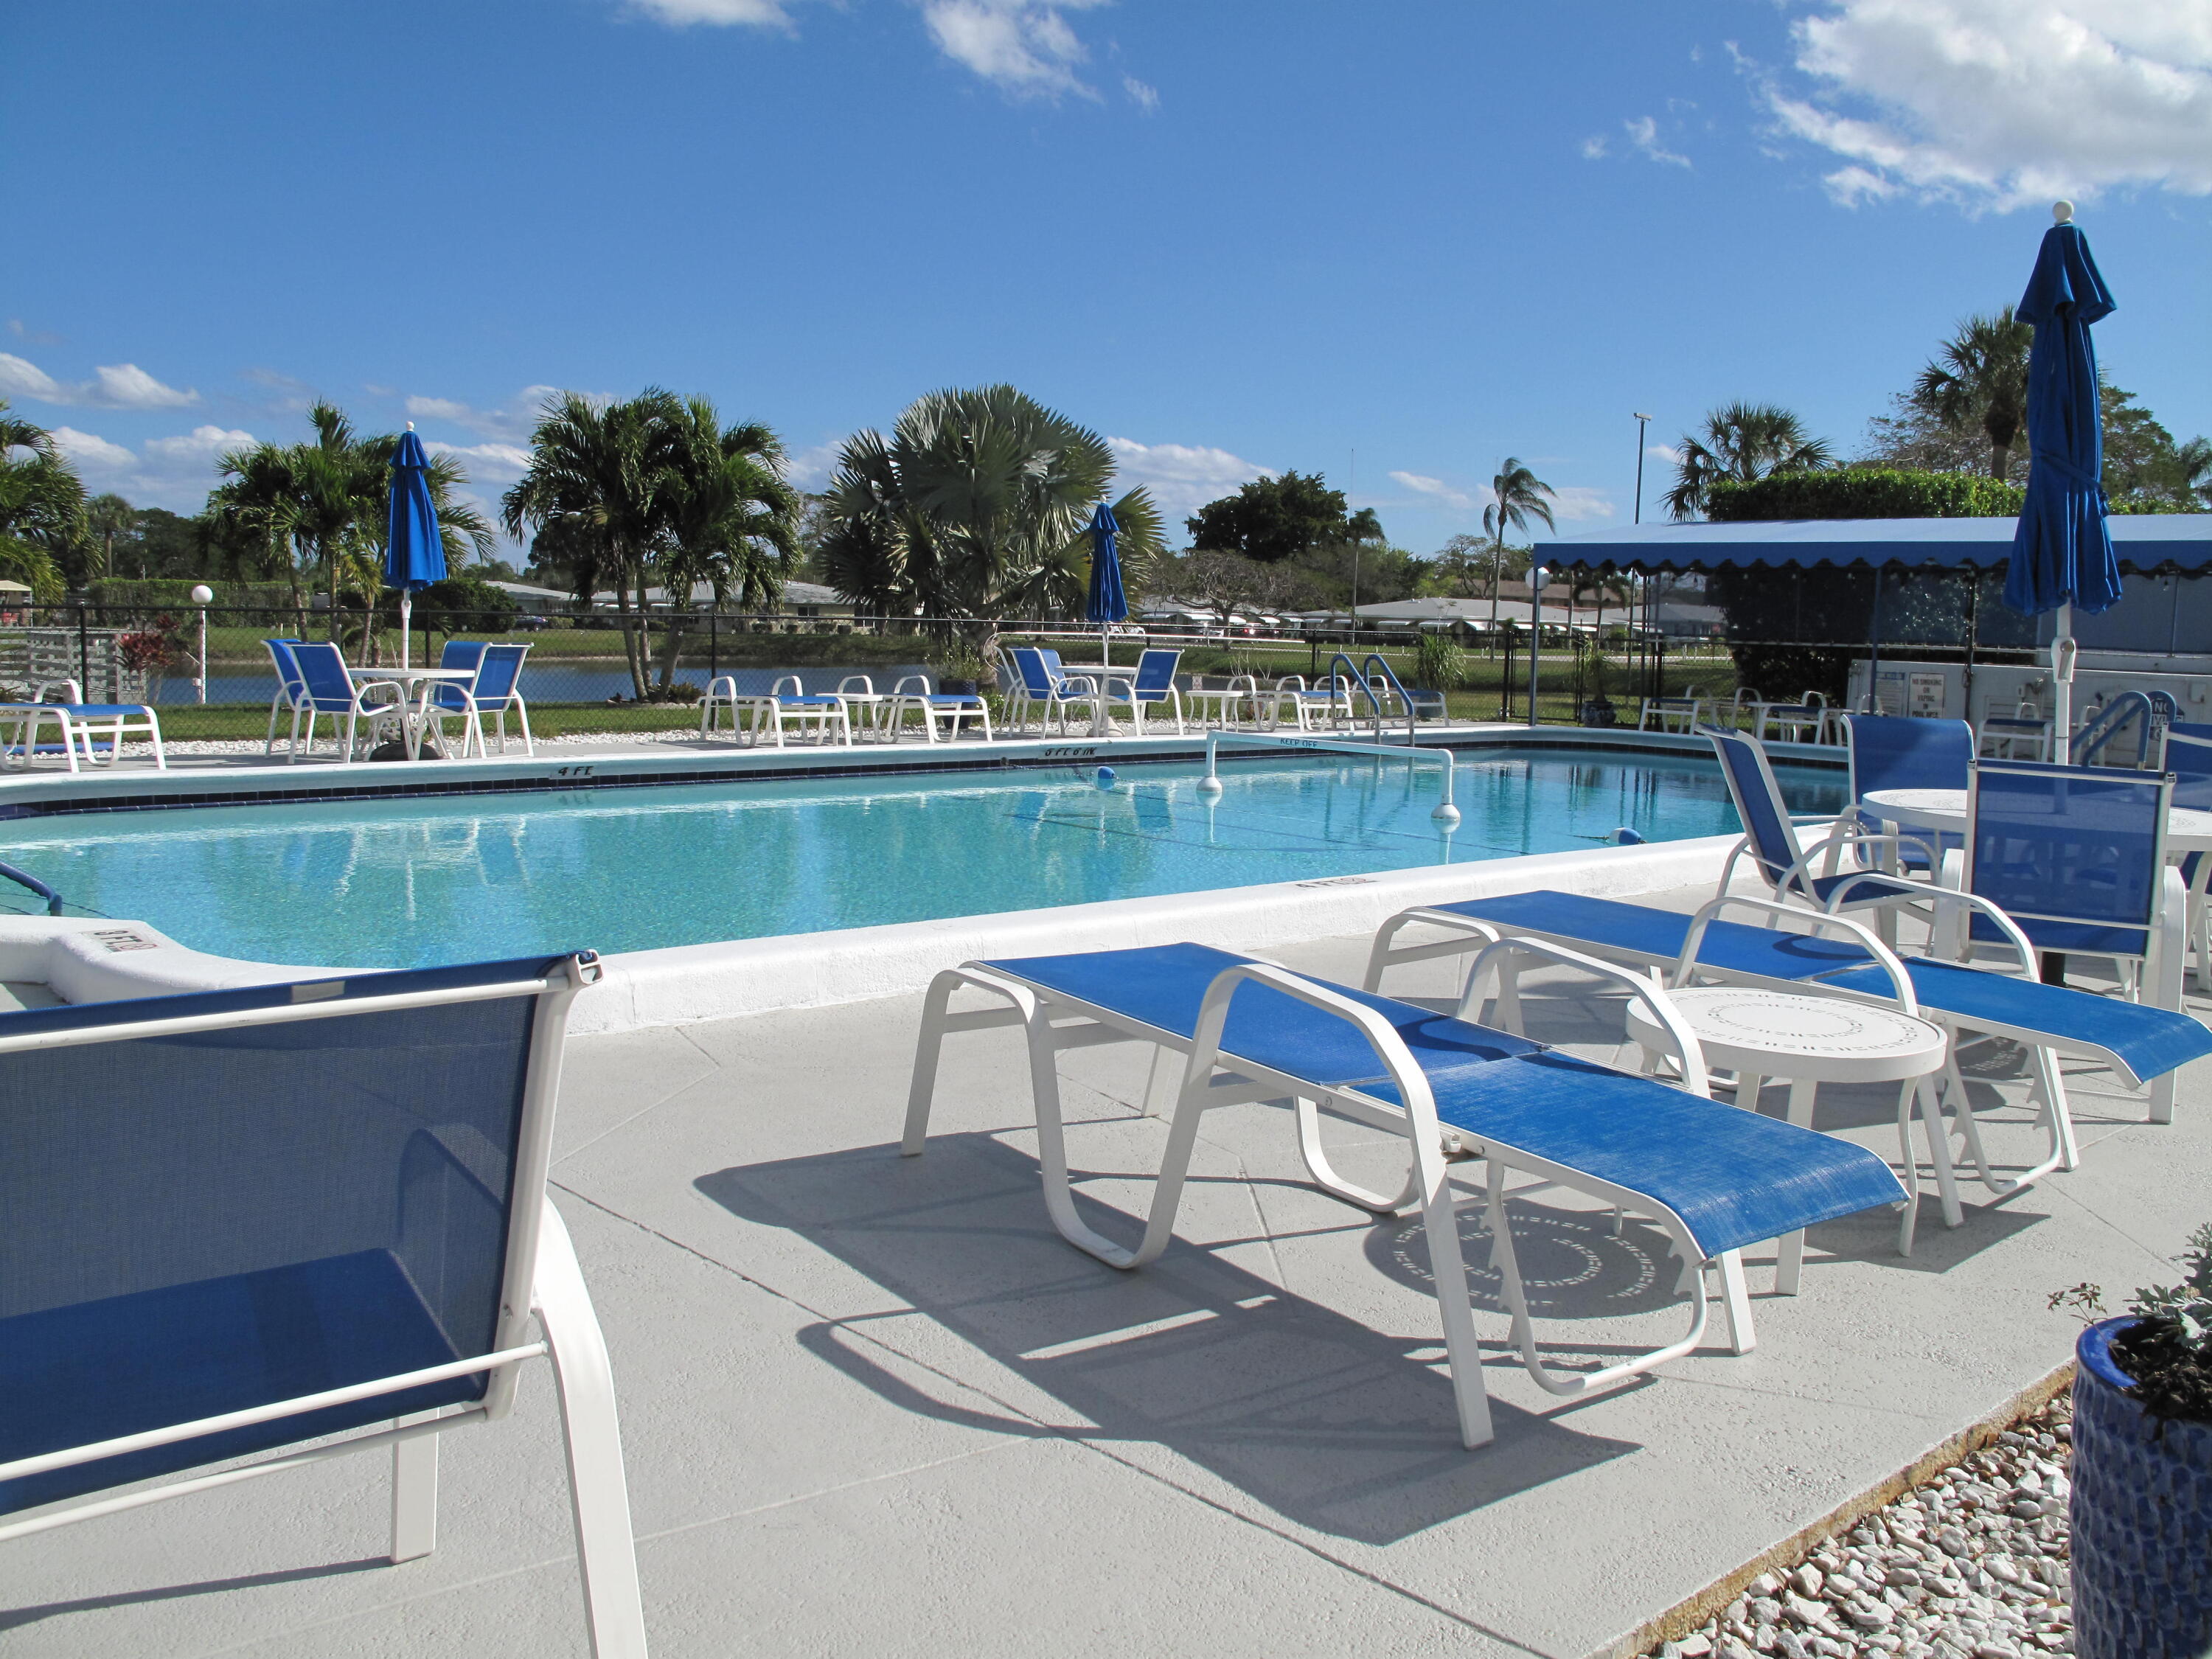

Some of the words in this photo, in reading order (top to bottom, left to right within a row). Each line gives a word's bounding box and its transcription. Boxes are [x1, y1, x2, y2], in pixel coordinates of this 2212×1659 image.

[1280, 737, 1299, 746] KEEP
[1302, 740, 1318, 748] OFF
[558, 767, 568, 776] 4
